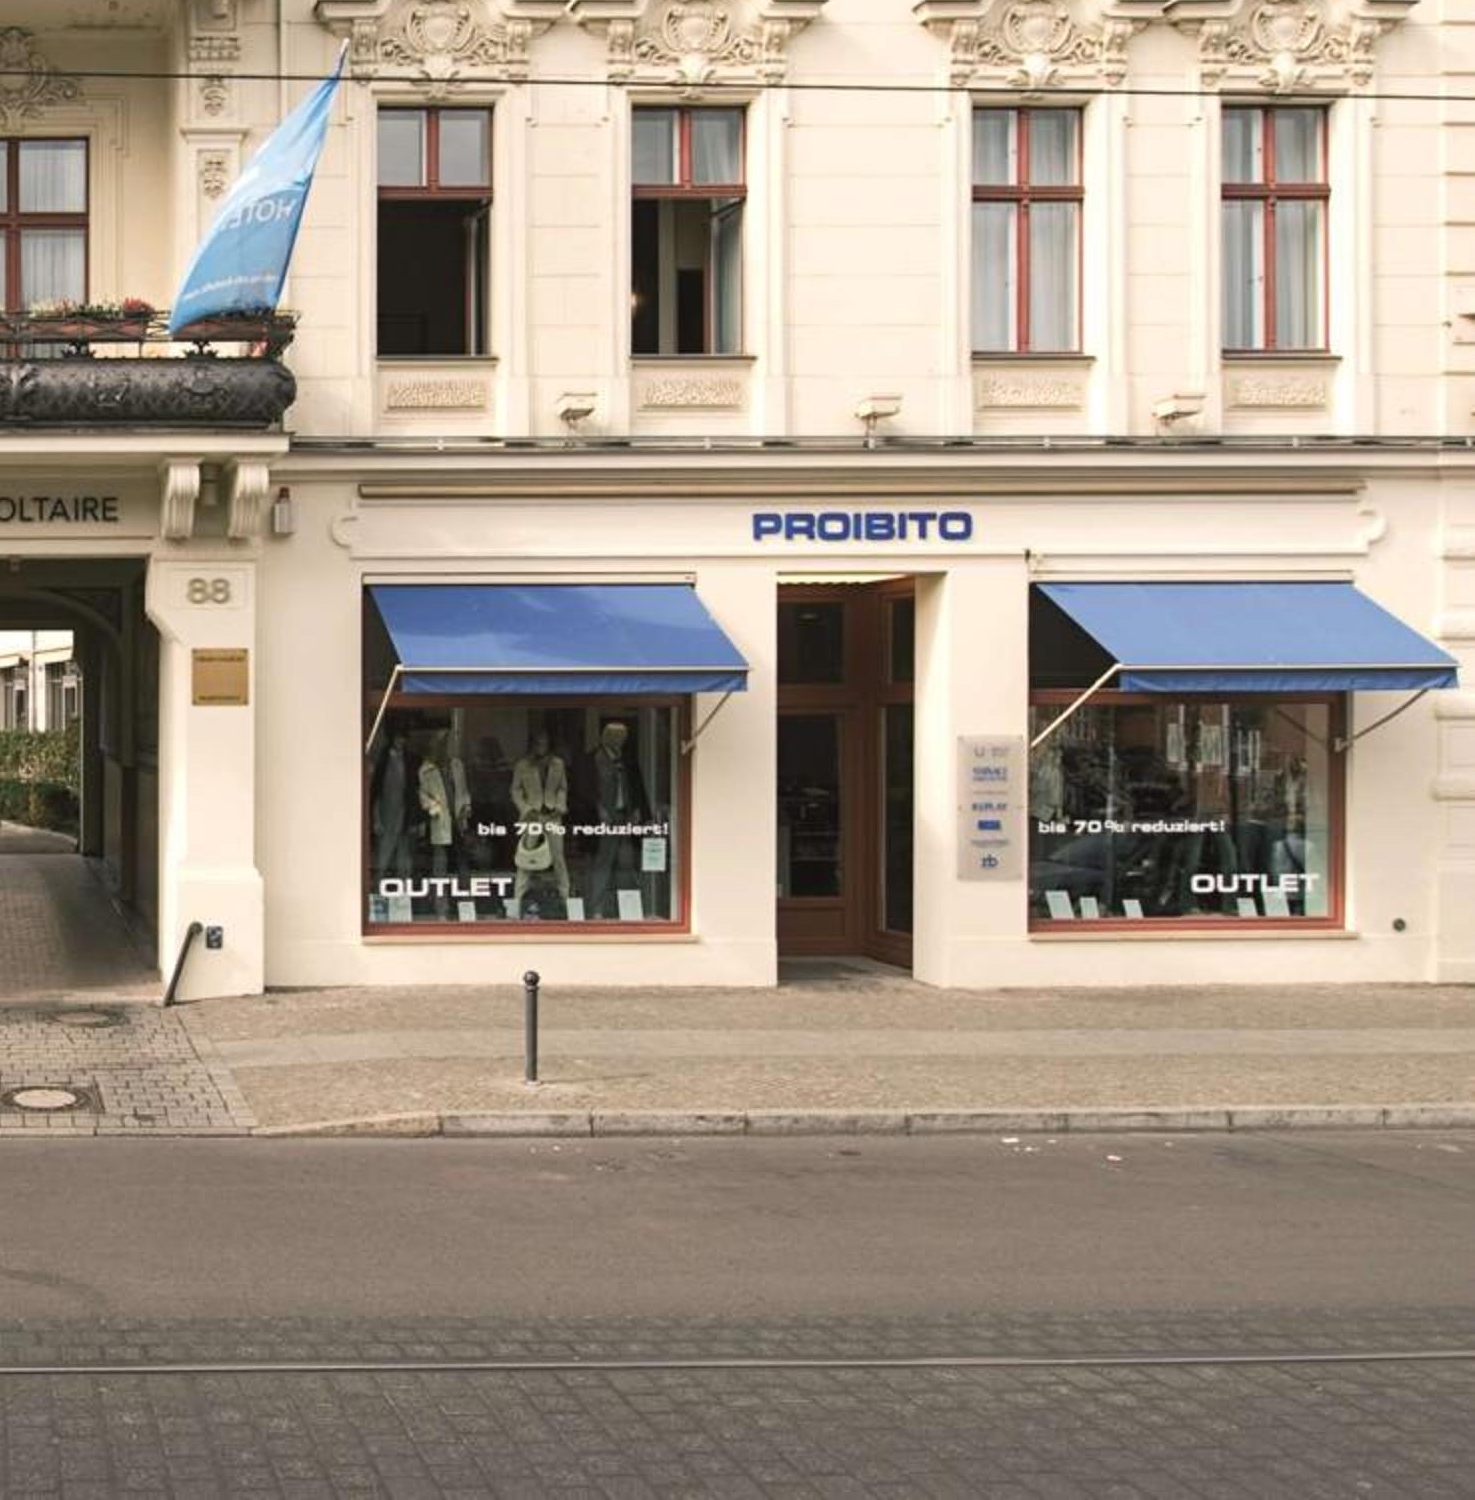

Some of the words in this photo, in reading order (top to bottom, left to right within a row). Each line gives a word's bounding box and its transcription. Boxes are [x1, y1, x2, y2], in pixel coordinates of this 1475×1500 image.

[753, 512, 973, 541] PROIBITO
[187, 578, 231, 604] 88
[478, 822, 507, 835] bis
[573, 821, 669, 835] reduziert!
[1038, 821, 1066, 834] bis
[1131, 819, 1226, 833] reduziert!
[379, 877, 512, 897] OUTLET
[1190, 873, 1319, 893] OUTLET
